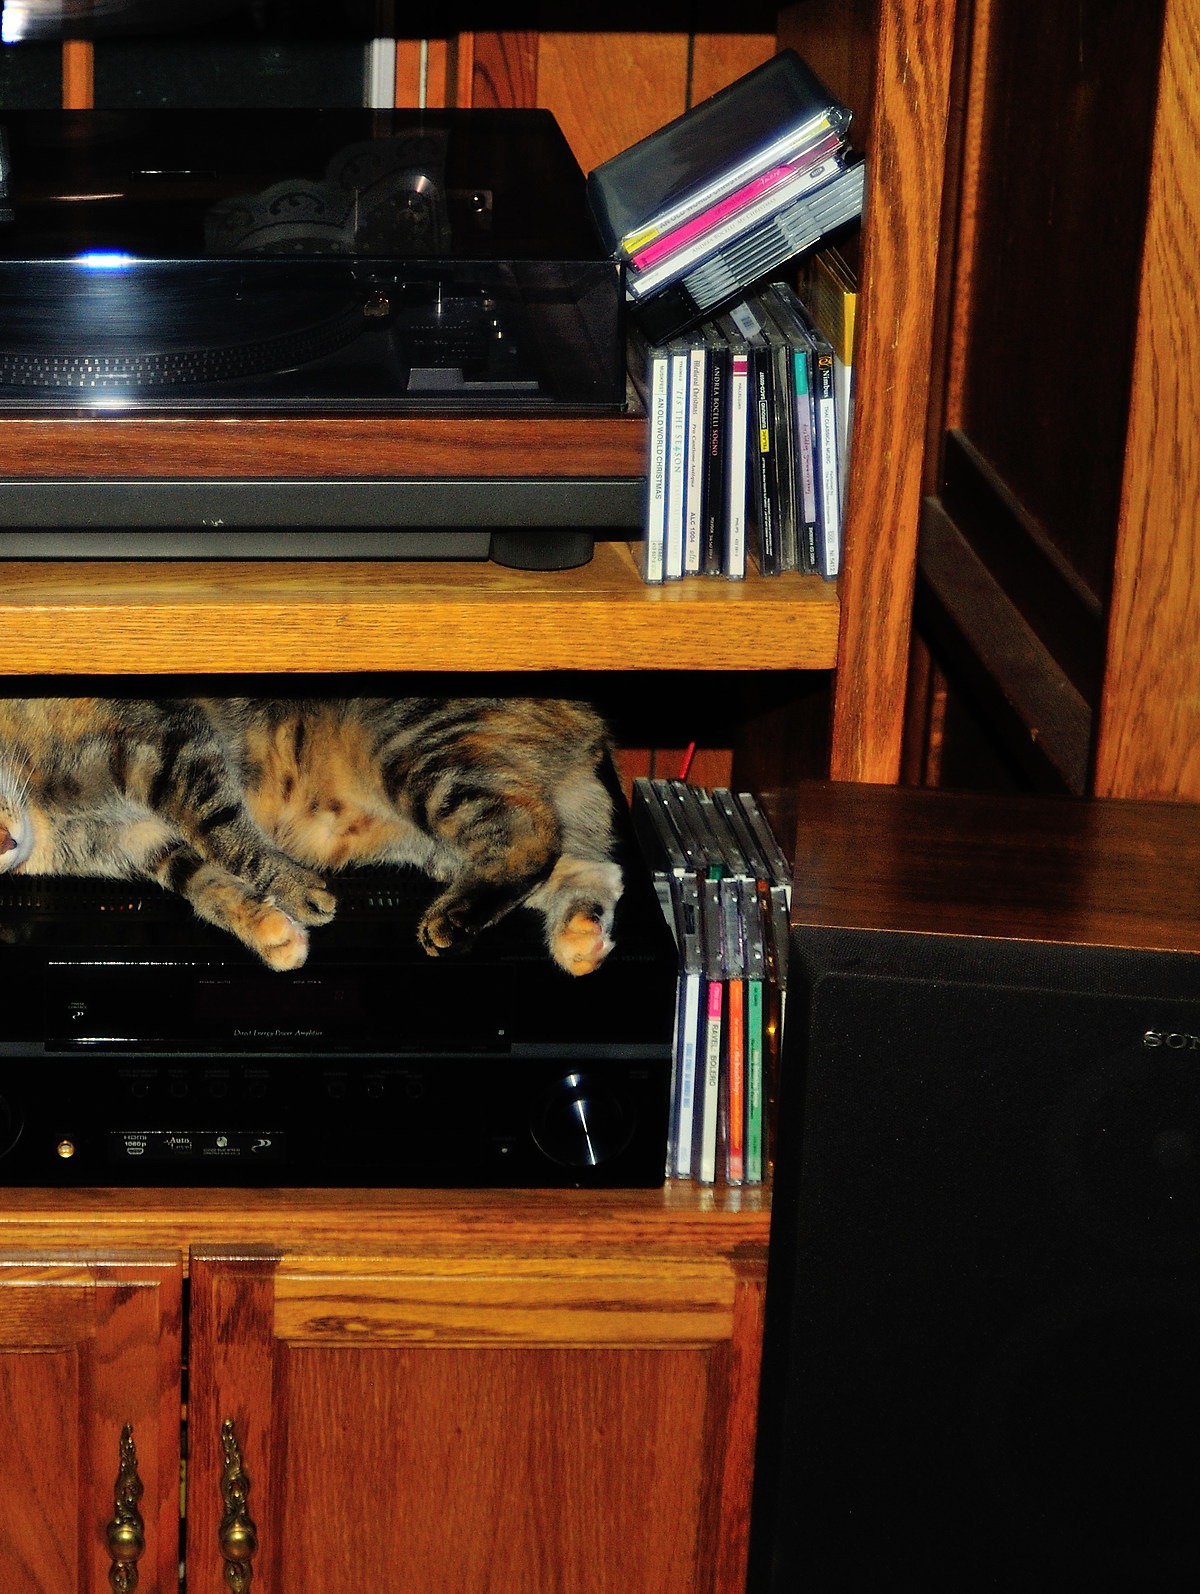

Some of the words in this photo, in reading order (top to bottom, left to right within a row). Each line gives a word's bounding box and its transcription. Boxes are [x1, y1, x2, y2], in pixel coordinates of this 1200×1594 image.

[692, 360, 700, 386] Medieval
[822, 369, 830, 397] Nimbus
[657, 397, 663, 408] AN
[654, 456, 662, 499] CHRISTMAS
[709, 1055, 717, 1086] BOLERO
